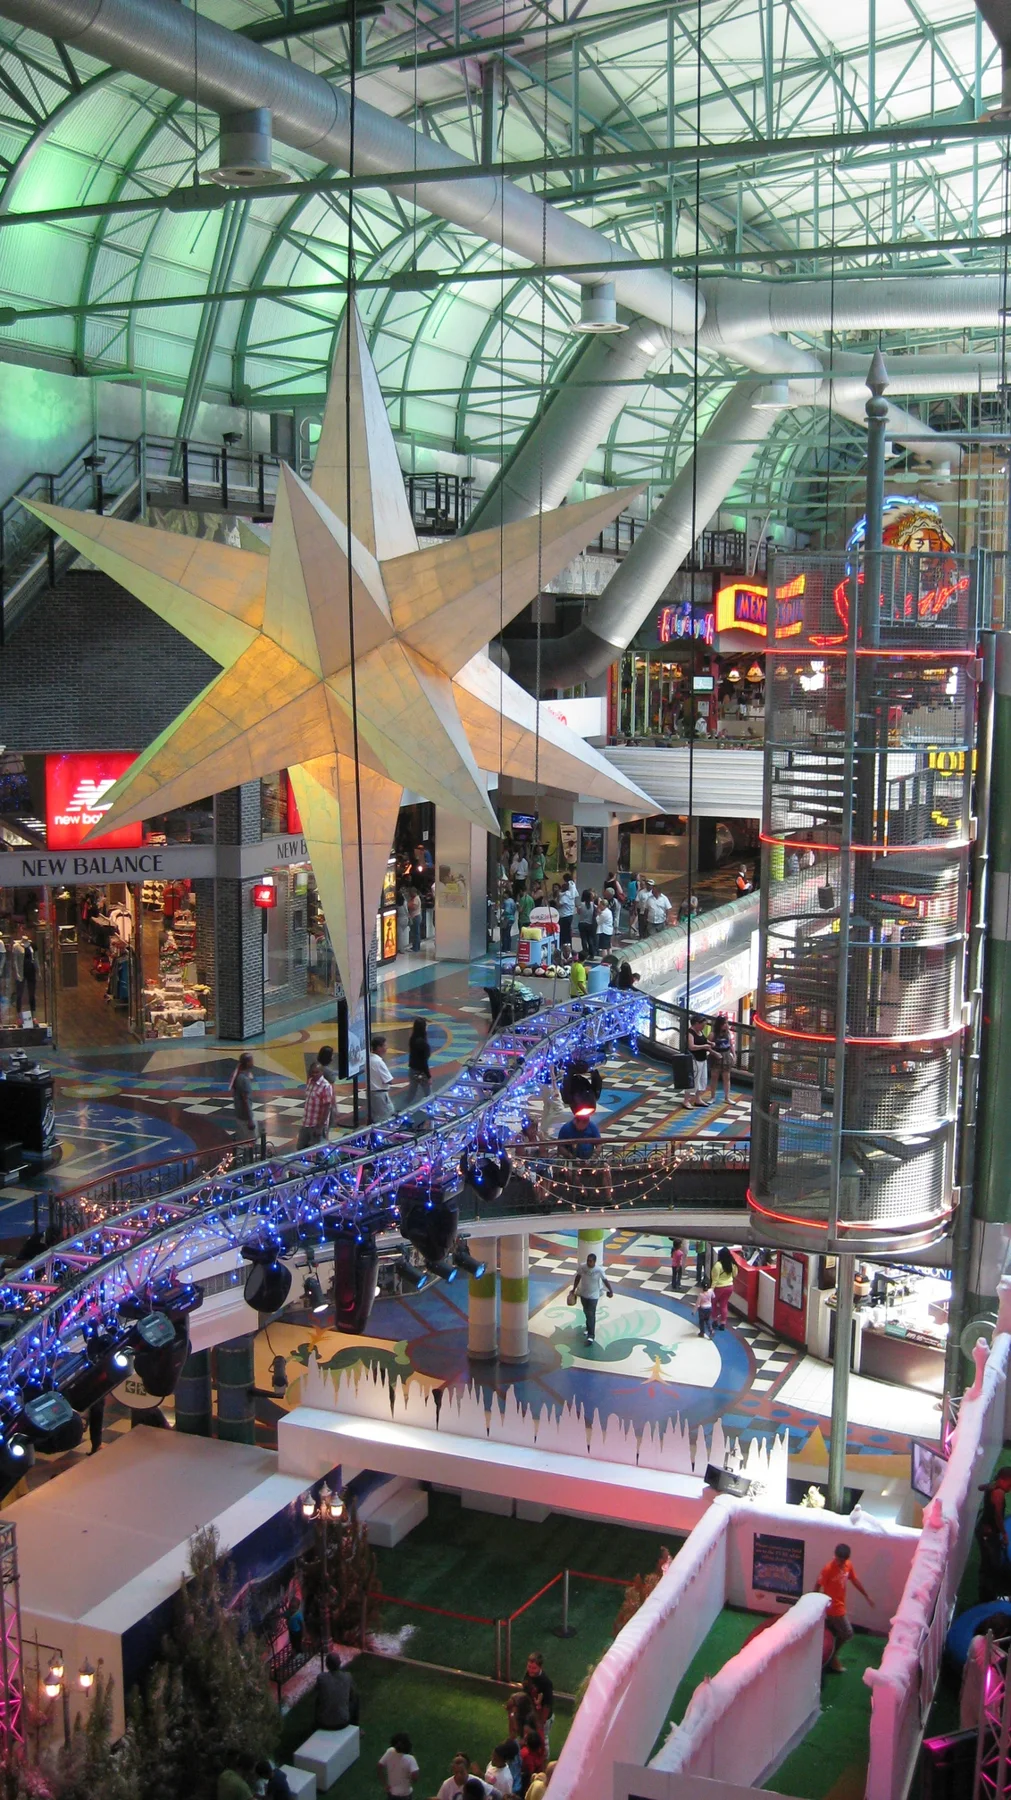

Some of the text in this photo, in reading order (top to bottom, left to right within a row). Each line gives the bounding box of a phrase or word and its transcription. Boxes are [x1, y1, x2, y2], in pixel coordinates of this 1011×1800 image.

[54, 815, 80, 825] new
[277, 841, 299, 859] NEW
[22, 854, 164, 877] NEW BALANCE
